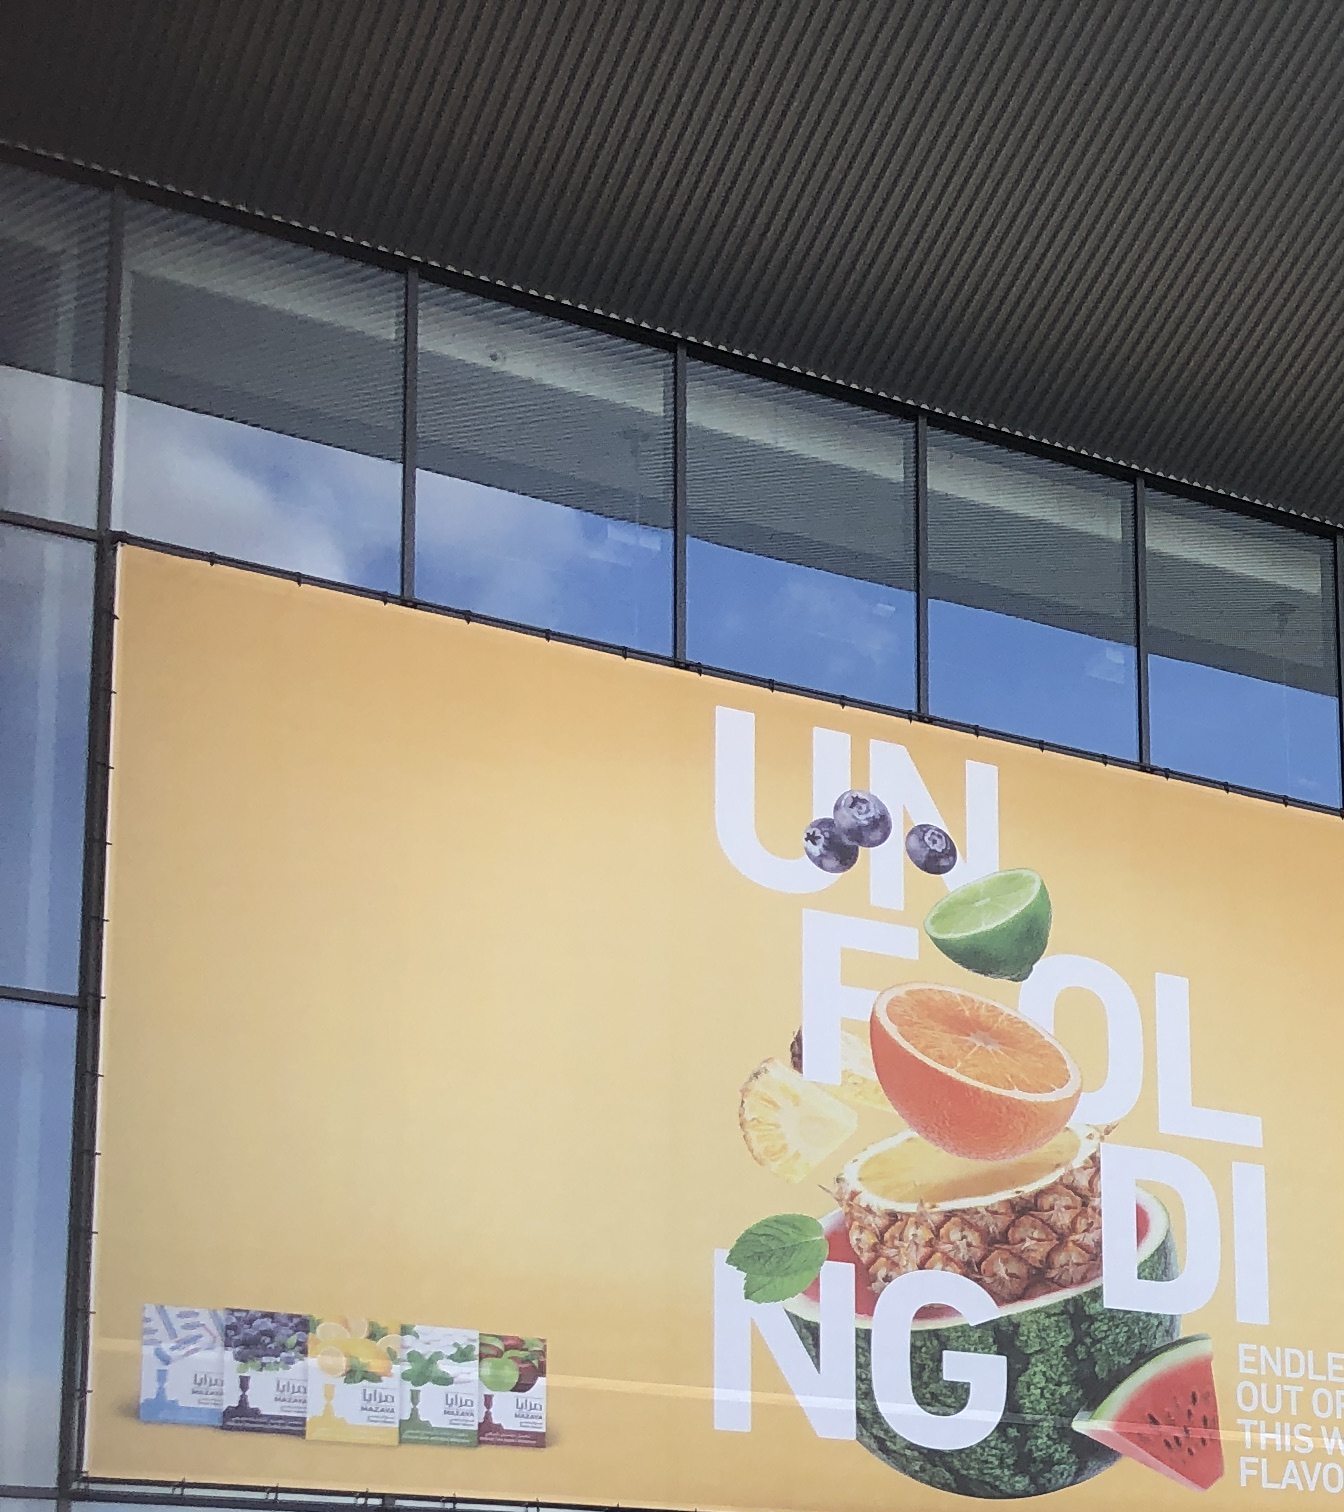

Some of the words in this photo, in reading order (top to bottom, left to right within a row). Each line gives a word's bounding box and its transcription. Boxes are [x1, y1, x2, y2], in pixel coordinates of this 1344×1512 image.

[715, 706, 999, 911] UN
[1100, 1142, 1271, 1325] DI
[712, 1248, 1008, 1450] NG
[1236, 1381, 1303, 1416] OUT
[1237, 1418, 1314, 1454] THIS
